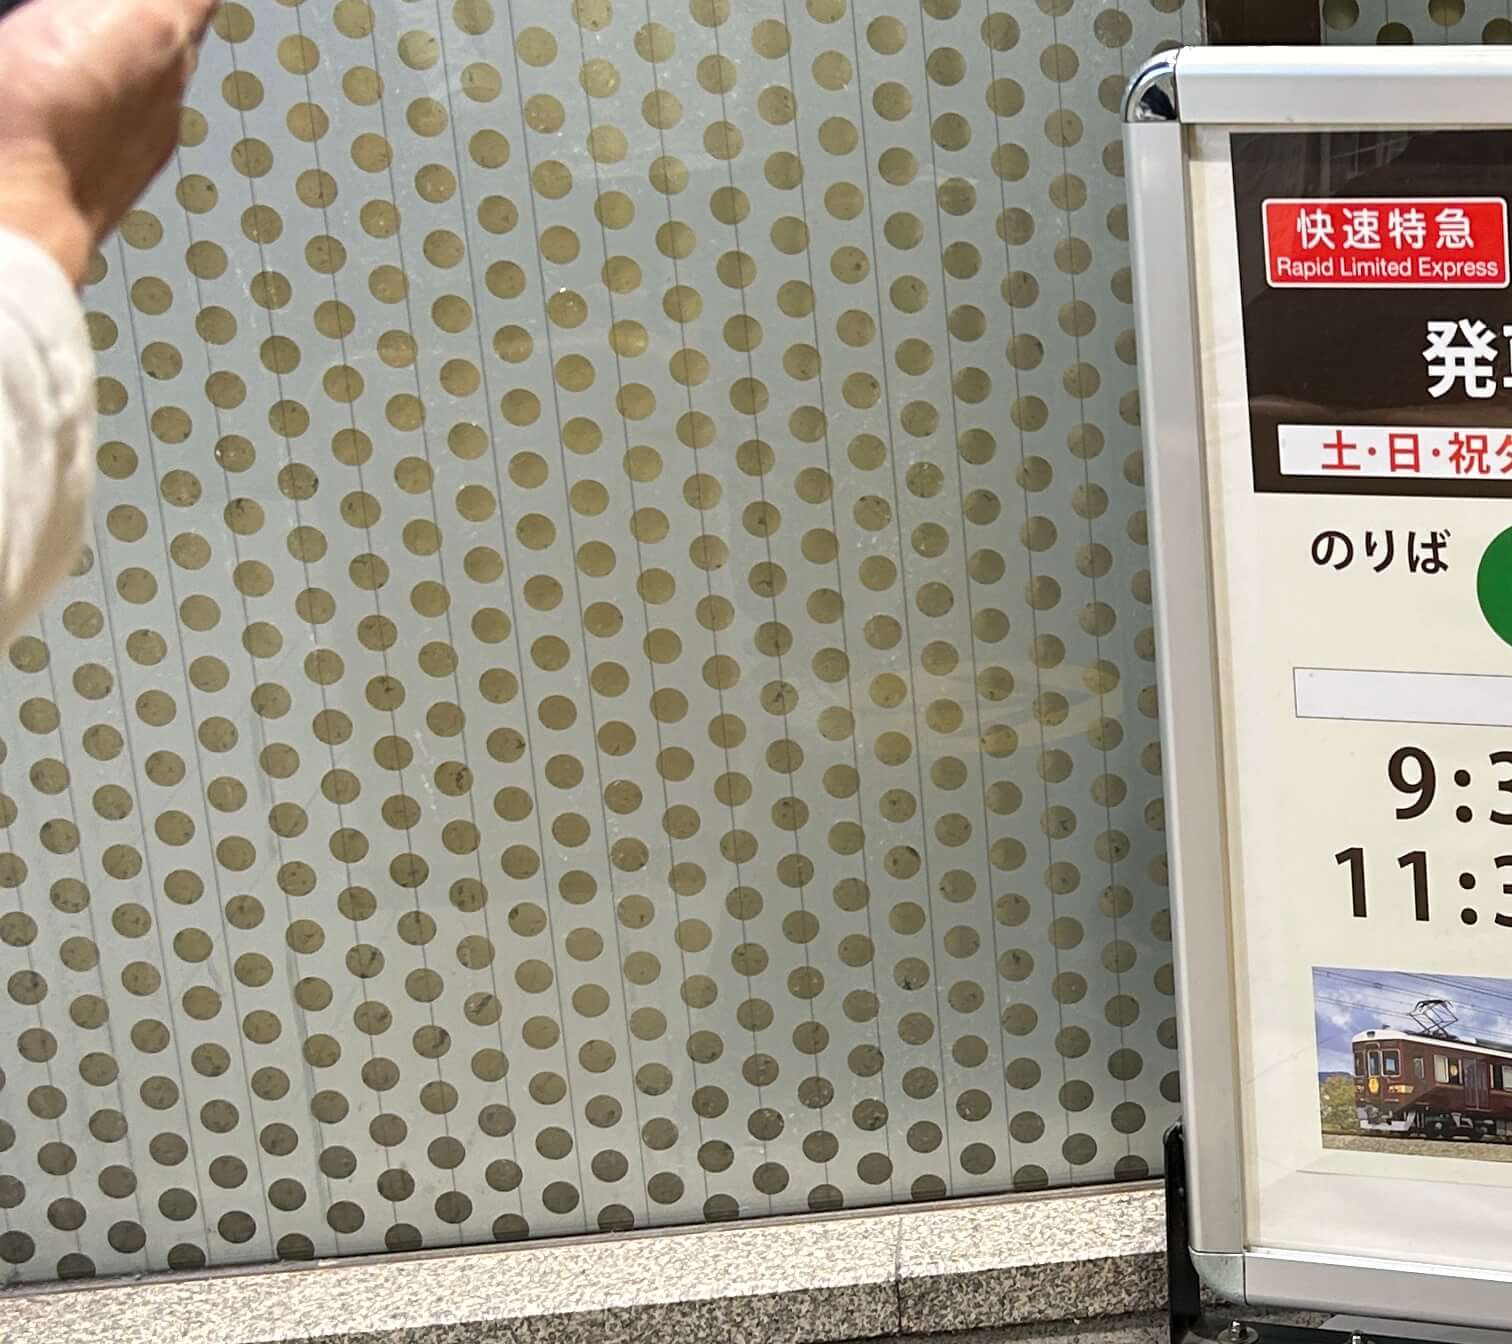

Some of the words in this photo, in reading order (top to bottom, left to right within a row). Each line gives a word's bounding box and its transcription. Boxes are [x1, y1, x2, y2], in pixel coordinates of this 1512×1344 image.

[1296, 207, 1474, 250] 快速特急
[1276, 256, 1334, 281] Rapid
[1340, 257, 1412, 277] Limited
[1418, 256, 1499, 281] Express
[1311, 529, 1451, 574] のりば
